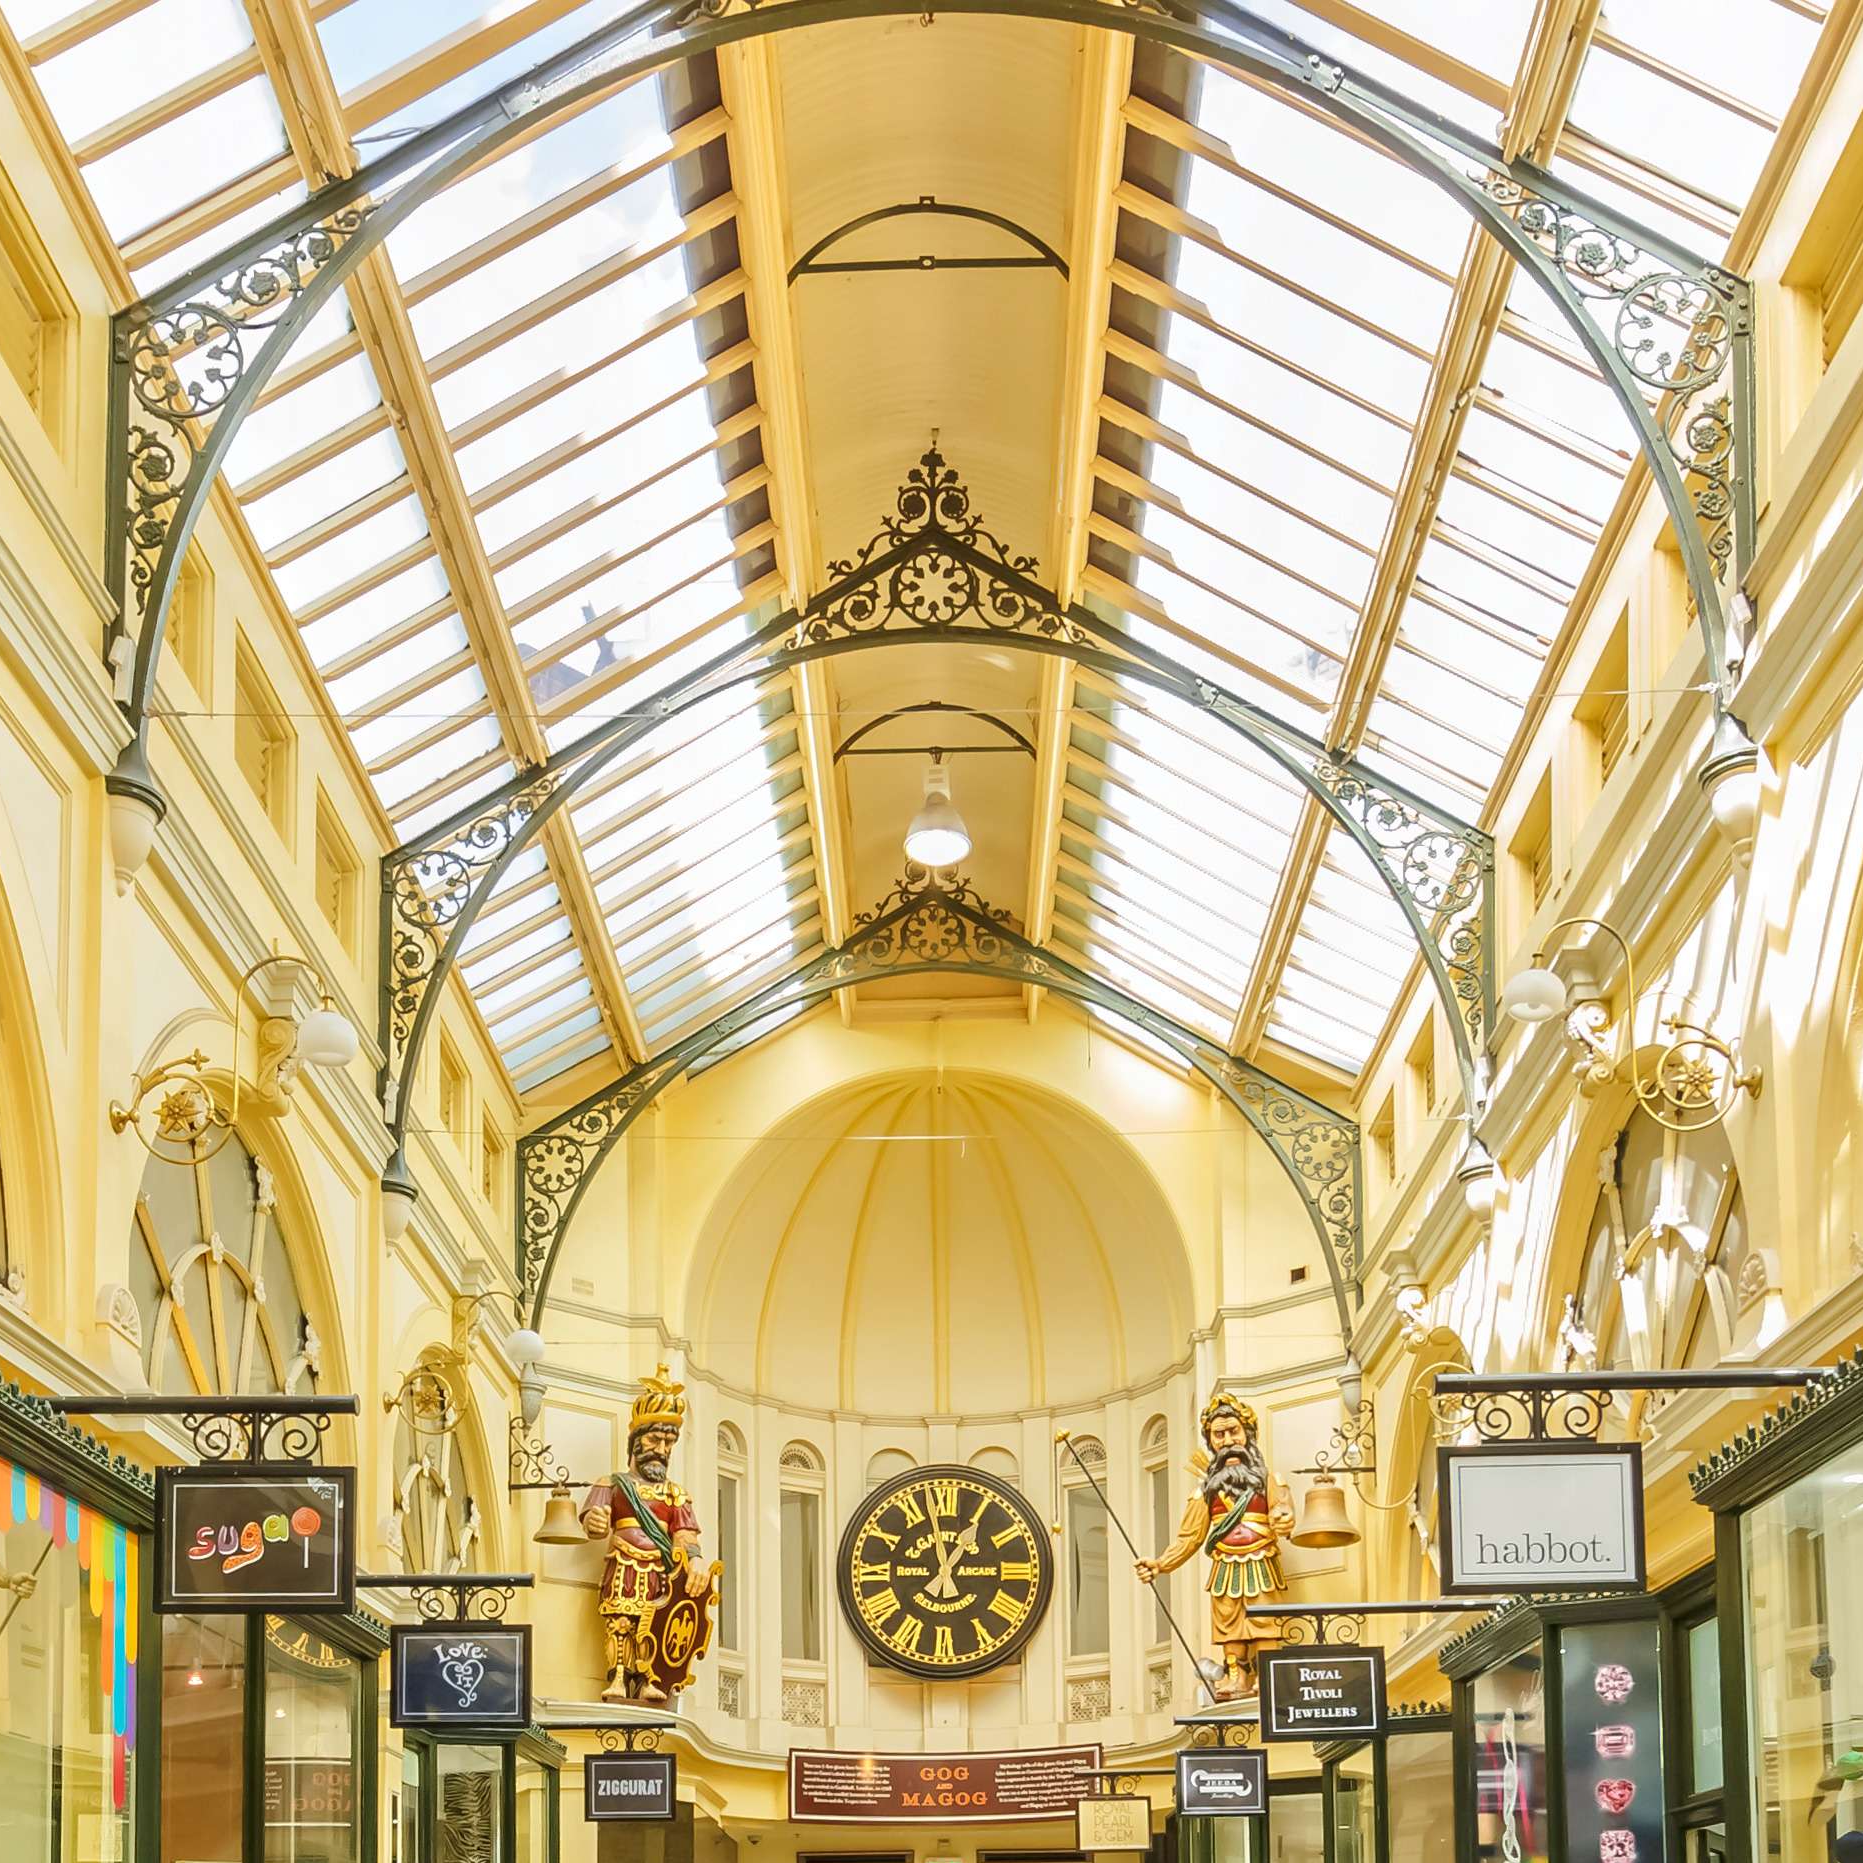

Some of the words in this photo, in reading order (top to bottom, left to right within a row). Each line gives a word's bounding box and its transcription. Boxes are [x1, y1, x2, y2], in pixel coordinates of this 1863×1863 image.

[1475, 1533, 1611, 1564] habbot.
[897, 1566, 929, 1576] ROYAL
[957, 1566, 997, 1576] ARCADE
[1299, 1667, 1342, 1682] ROYAL
[1299, 1686, 1343, 1700] TIVOLI
[1287, 1706, 1358, 1723] JEWELLERS
[920, 1767, 969, 1781] GOG
[598, 1780, 663, 1795] ZIGGURAT
[901, 1792, 987, 1806] MAGOG
